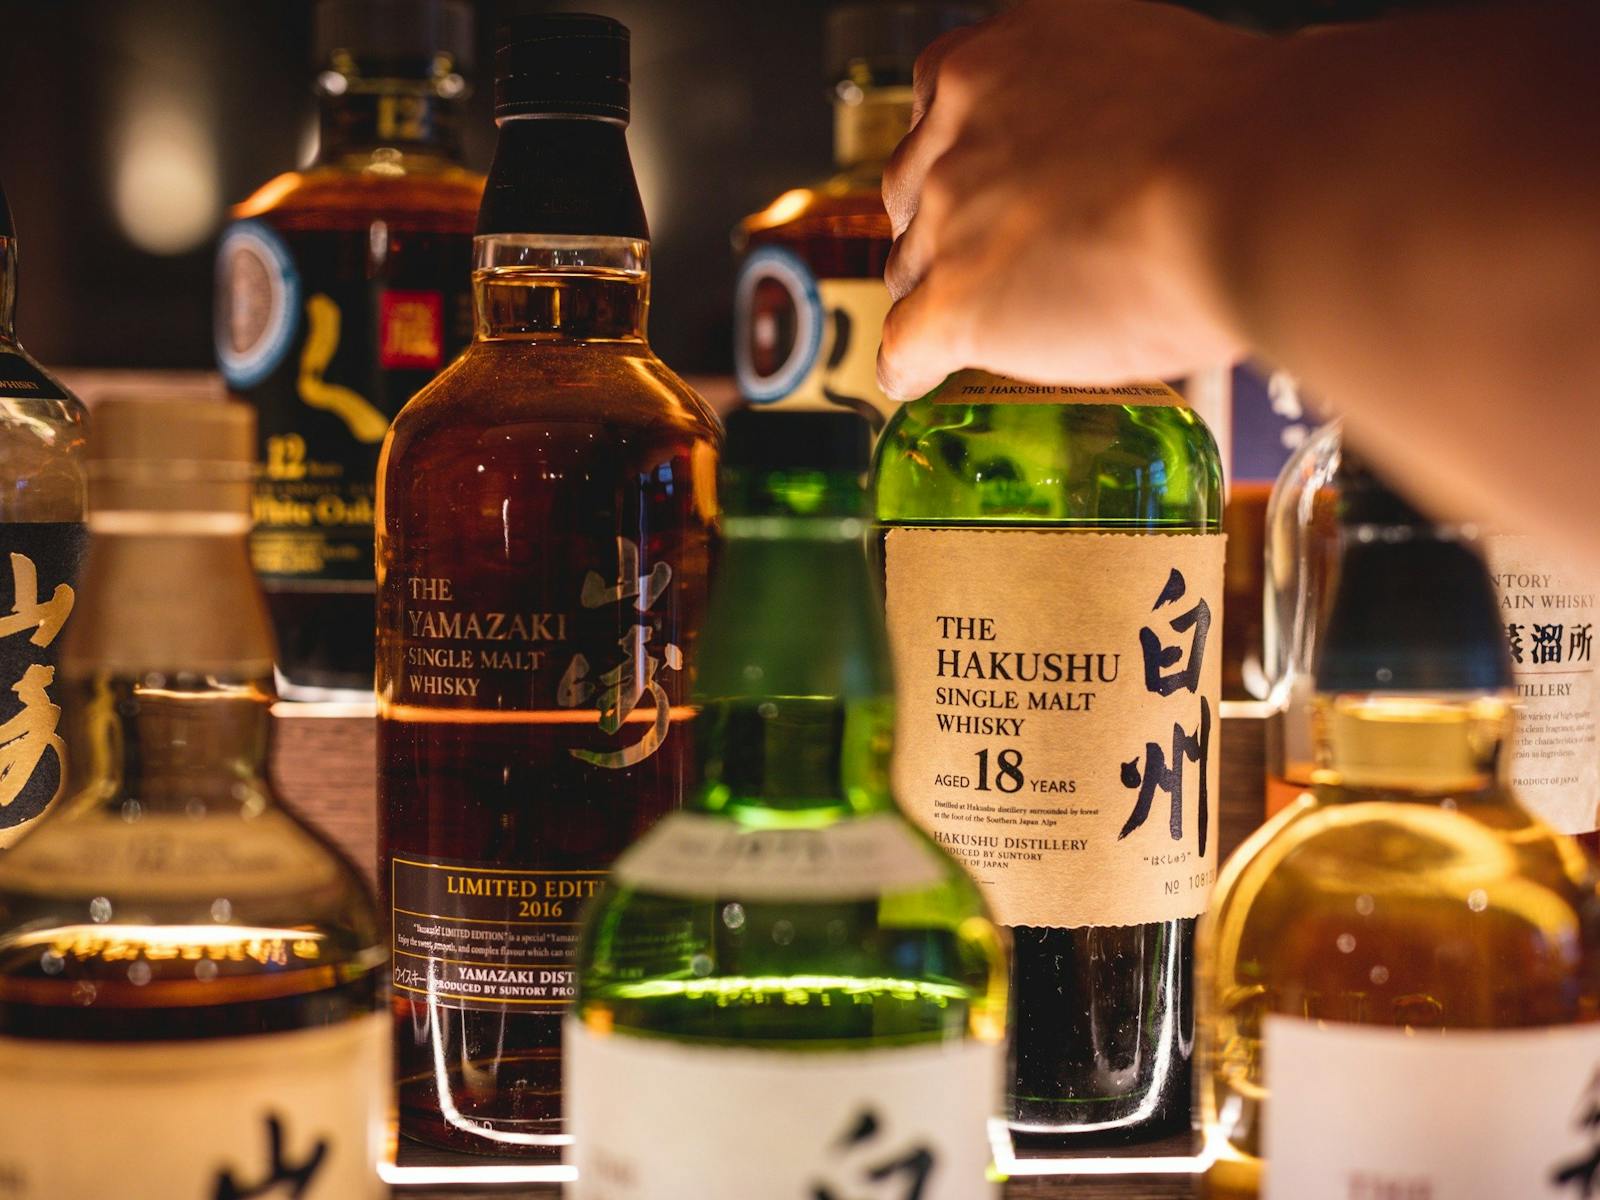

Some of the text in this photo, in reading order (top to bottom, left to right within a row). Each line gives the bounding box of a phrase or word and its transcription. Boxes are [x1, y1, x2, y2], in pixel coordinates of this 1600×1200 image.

[961, 386, 986, 395] THE
[990, 385, 1056, 395] HAKUSHU
[1060, 386, 1109, 395] SINGLE
[267, 432, 307, 480] 12
[408, 576, 454, 602] THE
[1489, 574, 1553, 589] NTORY
[1498, 594, 1597, 609] AIN WHISKY
[408, 610, 568, 642] YAMAZAKI
[936, 616, 996, 641] THE
[408, 646, 546, 672] SINGLE MALT
[936, 649, 1121, 683] HAKUSHU
[409, 674, 481, 698] WHISKY
[1515, 683, 1573, 698] TILLERY
[936, 687, 1096, 711] SINGLE MALT
[1117, 568, 1213, 859] 白州
[936, 714, 1025, 737] WHISKY
[934, 748, 1077, 794] AGED 18 YEARS
[1513, 777, 1549, 786] PRODUCT
[934, 800, 959, 810] Distilled
[967, 803, 996, 812] Hakushu
[997, 805, 1027, 815] distillery
[1029, 807, 1068, 815] surrounded
[1070, 807, 1079, 816] by
[951, 812, 964, 820] foot
[965, 813, 972, 822] of
[974, 814, 985, 822] the
[986, 815, 1018, 825] Southern
[1019, 818, 1039, 826] Japan
[1040, 819, 1057, 827] Alps
[934, 831, 1088, 851] HAKUSHU DISTILLERY
[943, 846, 1043, 862] ODUCED BY SUNTORY
[970, 859, 981, 867] OF
[983, 860, 1010, 869] JAPAN
[447, 875, 605, 899] LIMITED EDIT
[519, 901, 563, 918] 2016
[442, 927, 471, 939] LIMITED
[458, 944, 470, 954] and
[471, 945, 499, 957] complex
[500, 945, 525, 957] flavour
[527, 946, 549, 957] which
[458, 967, 576, 985] YAMAZAKI DIST
[434, 979, 576, 997] PRODUCED BY SUNTORY PRO
